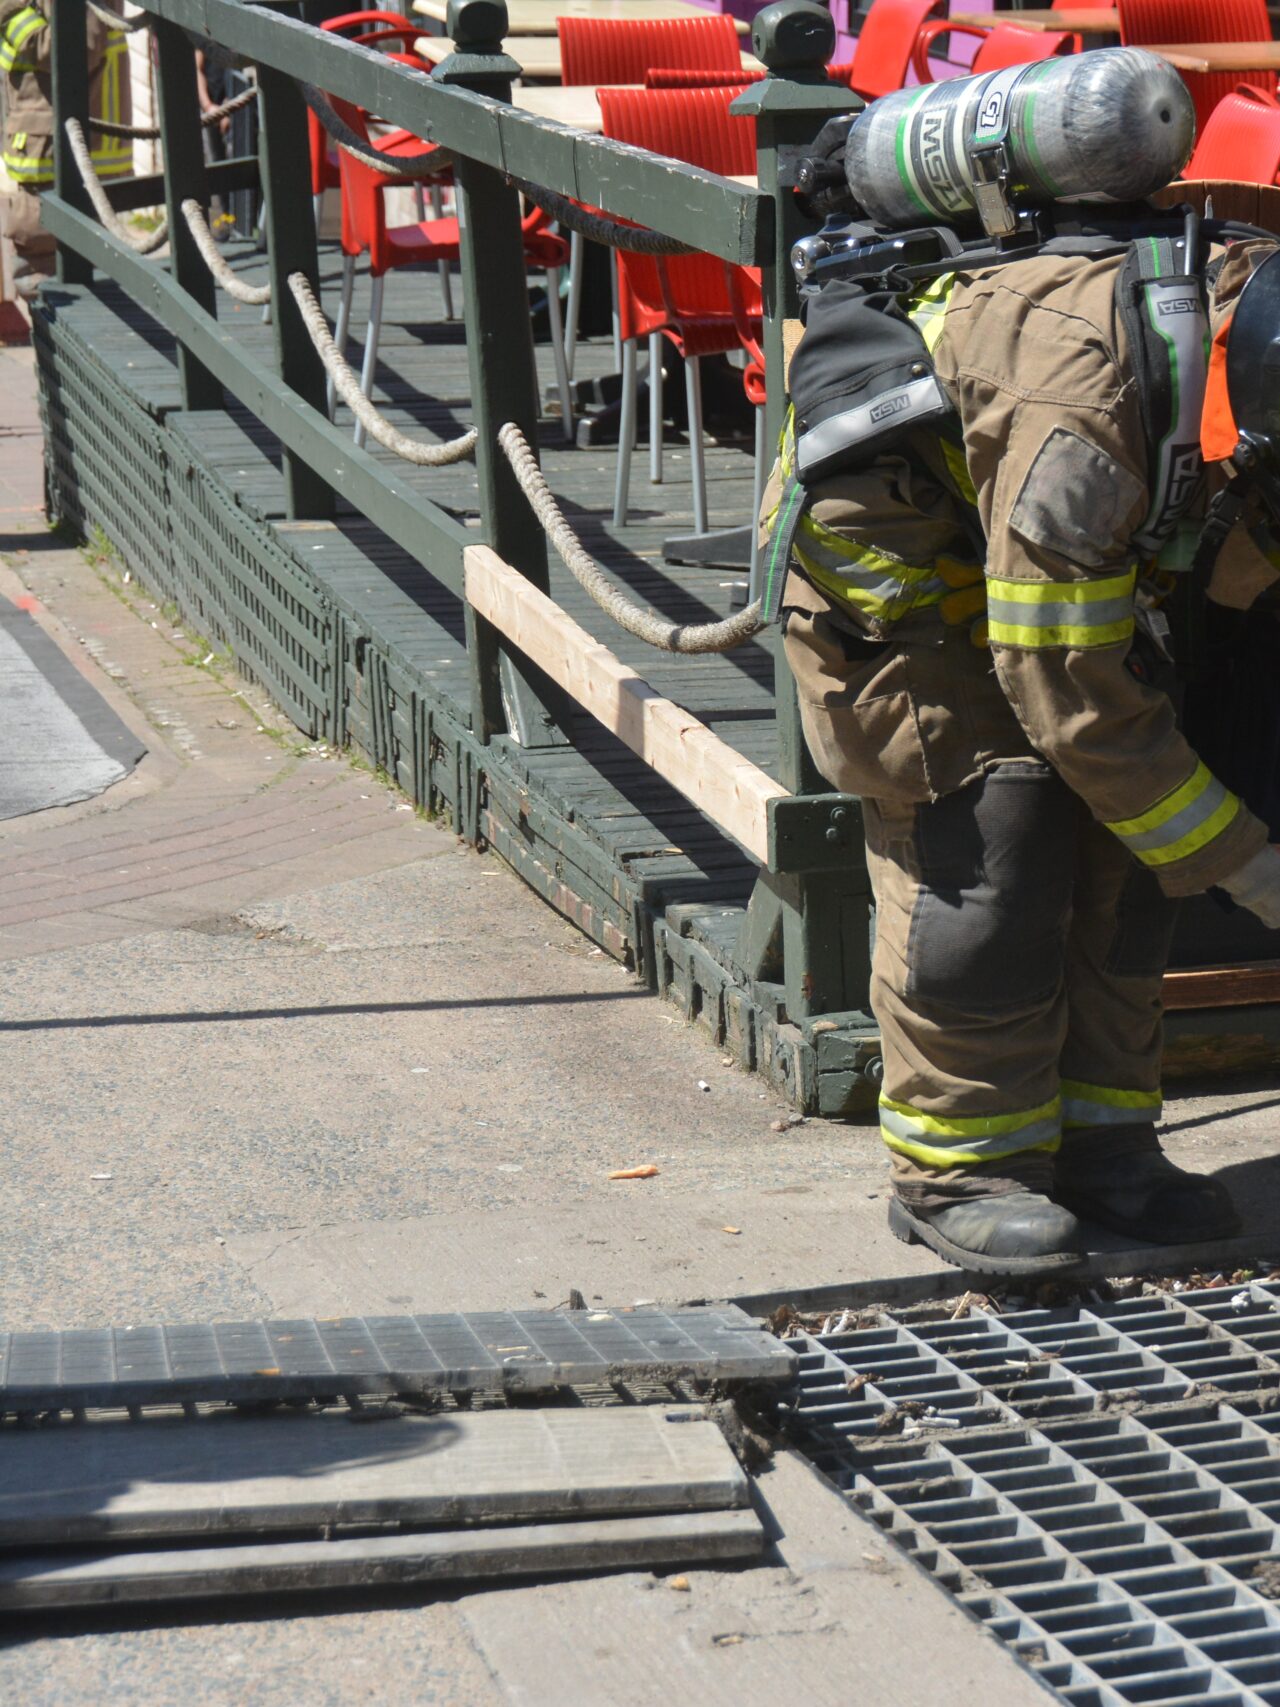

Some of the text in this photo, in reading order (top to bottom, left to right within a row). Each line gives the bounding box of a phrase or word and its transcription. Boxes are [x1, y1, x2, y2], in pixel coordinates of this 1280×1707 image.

[981, 92, 1003, 127] G1
[923, 117, 963, 209] MSA
[1159, 299, 1200, 314] MSA
[871, 395, 908, 420] MSA
